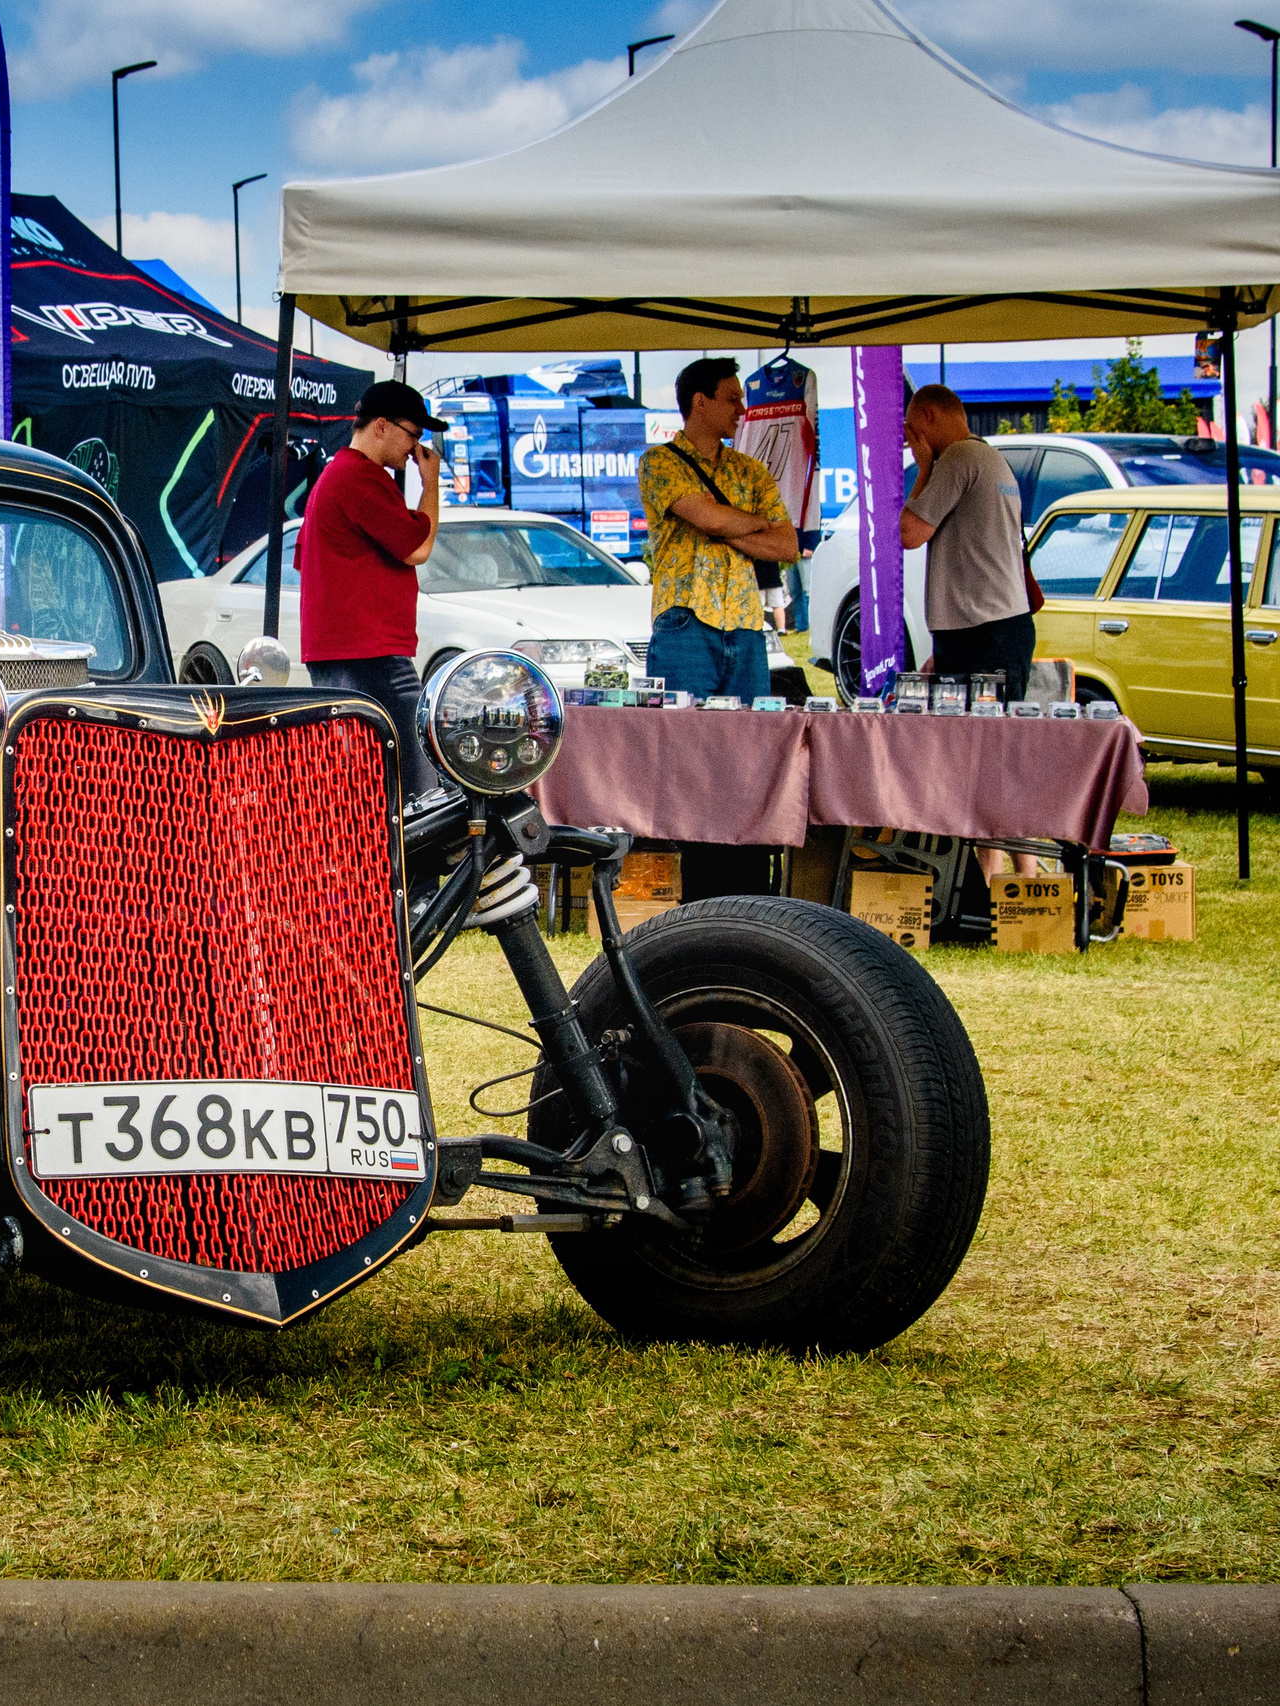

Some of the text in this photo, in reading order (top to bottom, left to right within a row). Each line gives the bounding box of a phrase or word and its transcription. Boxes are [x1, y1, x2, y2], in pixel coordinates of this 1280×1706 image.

[11, 302, 233, 348] VIPER
[62, 361, 156, 390] ОСВЕЩАЯ ПУТЬ
[232, 372, 276, 400] ОПЕРЕЖ
[551, 453, 636, 477] ГАЗПРОМ
[1025, 884, 1059, 897] TOYS
[1150, 873, 1184, 886] TOYS
[327, 1093, 406, 1147] 750
[351, 1148, 389, 1168] RUS
